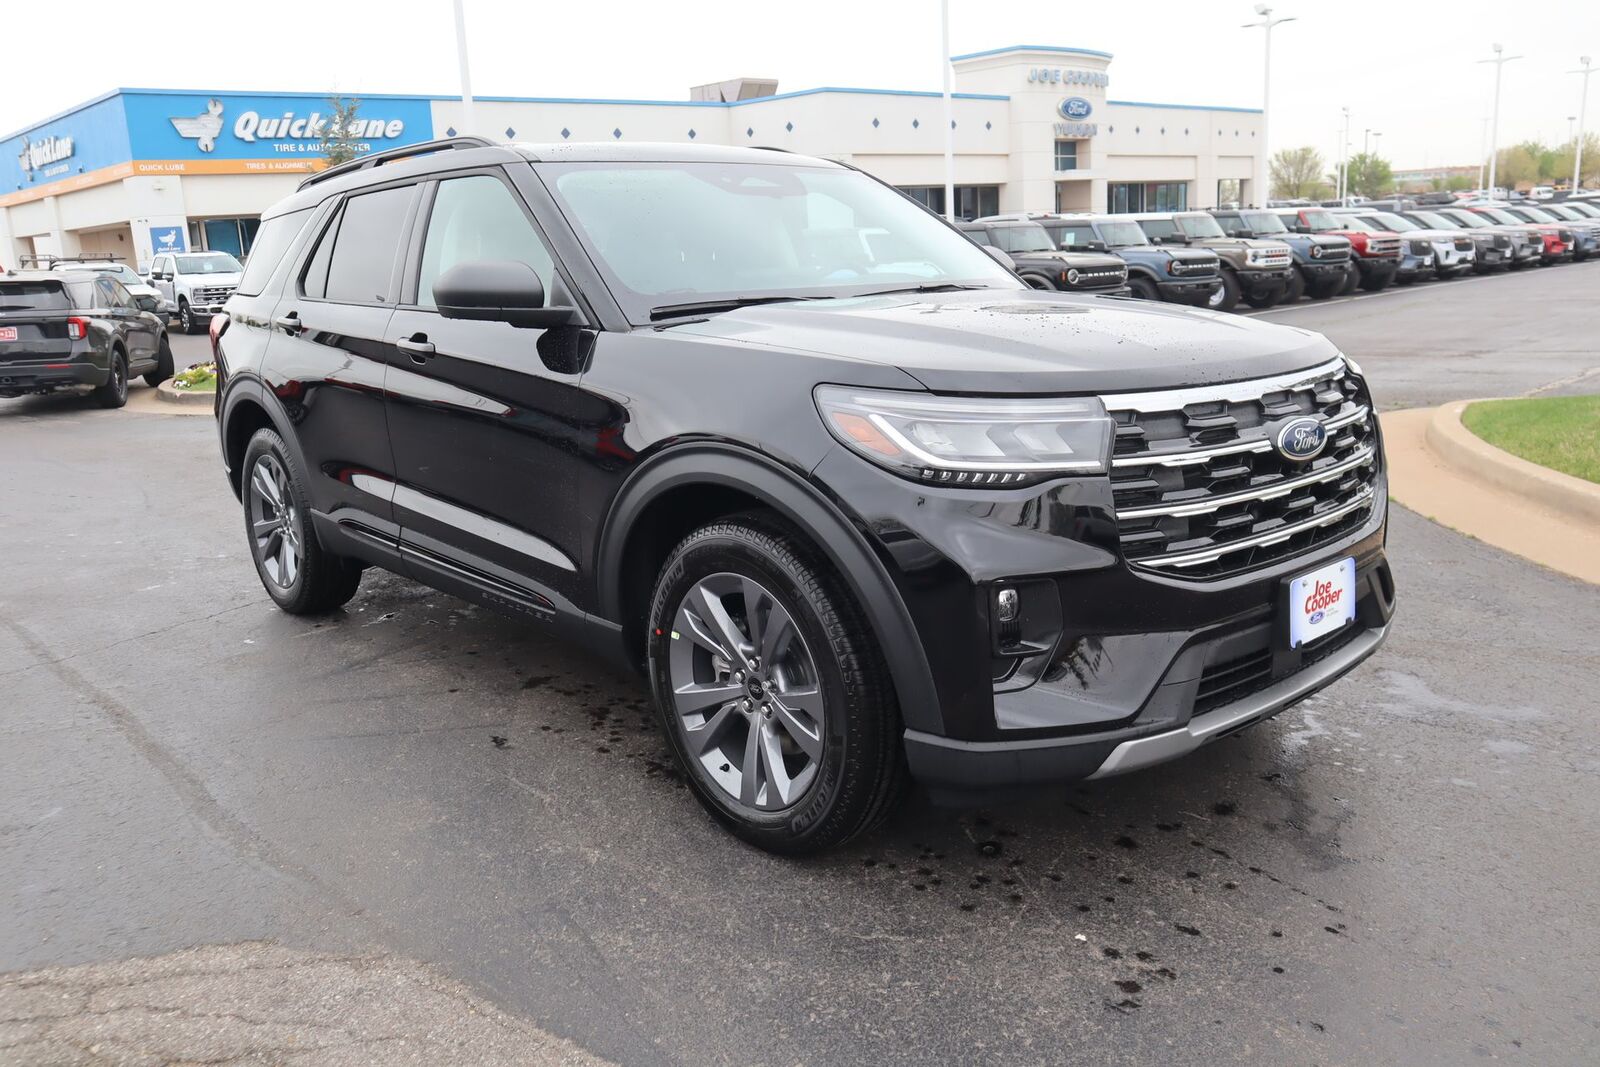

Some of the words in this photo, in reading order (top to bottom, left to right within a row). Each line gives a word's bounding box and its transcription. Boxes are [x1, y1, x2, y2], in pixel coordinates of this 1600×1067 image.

[1028, 68, 1061, 84] JOE
[233, 111, 327, 143] Quick
[273, 143, 297, 153] TIRE
[297, 143, 305, 152] &
[333, 143, 371, 152] TER
[139, 163, 164, 172] QUICK
[1293, 427, 1320, 449] Ford
[1312, 580, 1332, 599] Joe
[1304, 588, 1343, 615] Cooper
